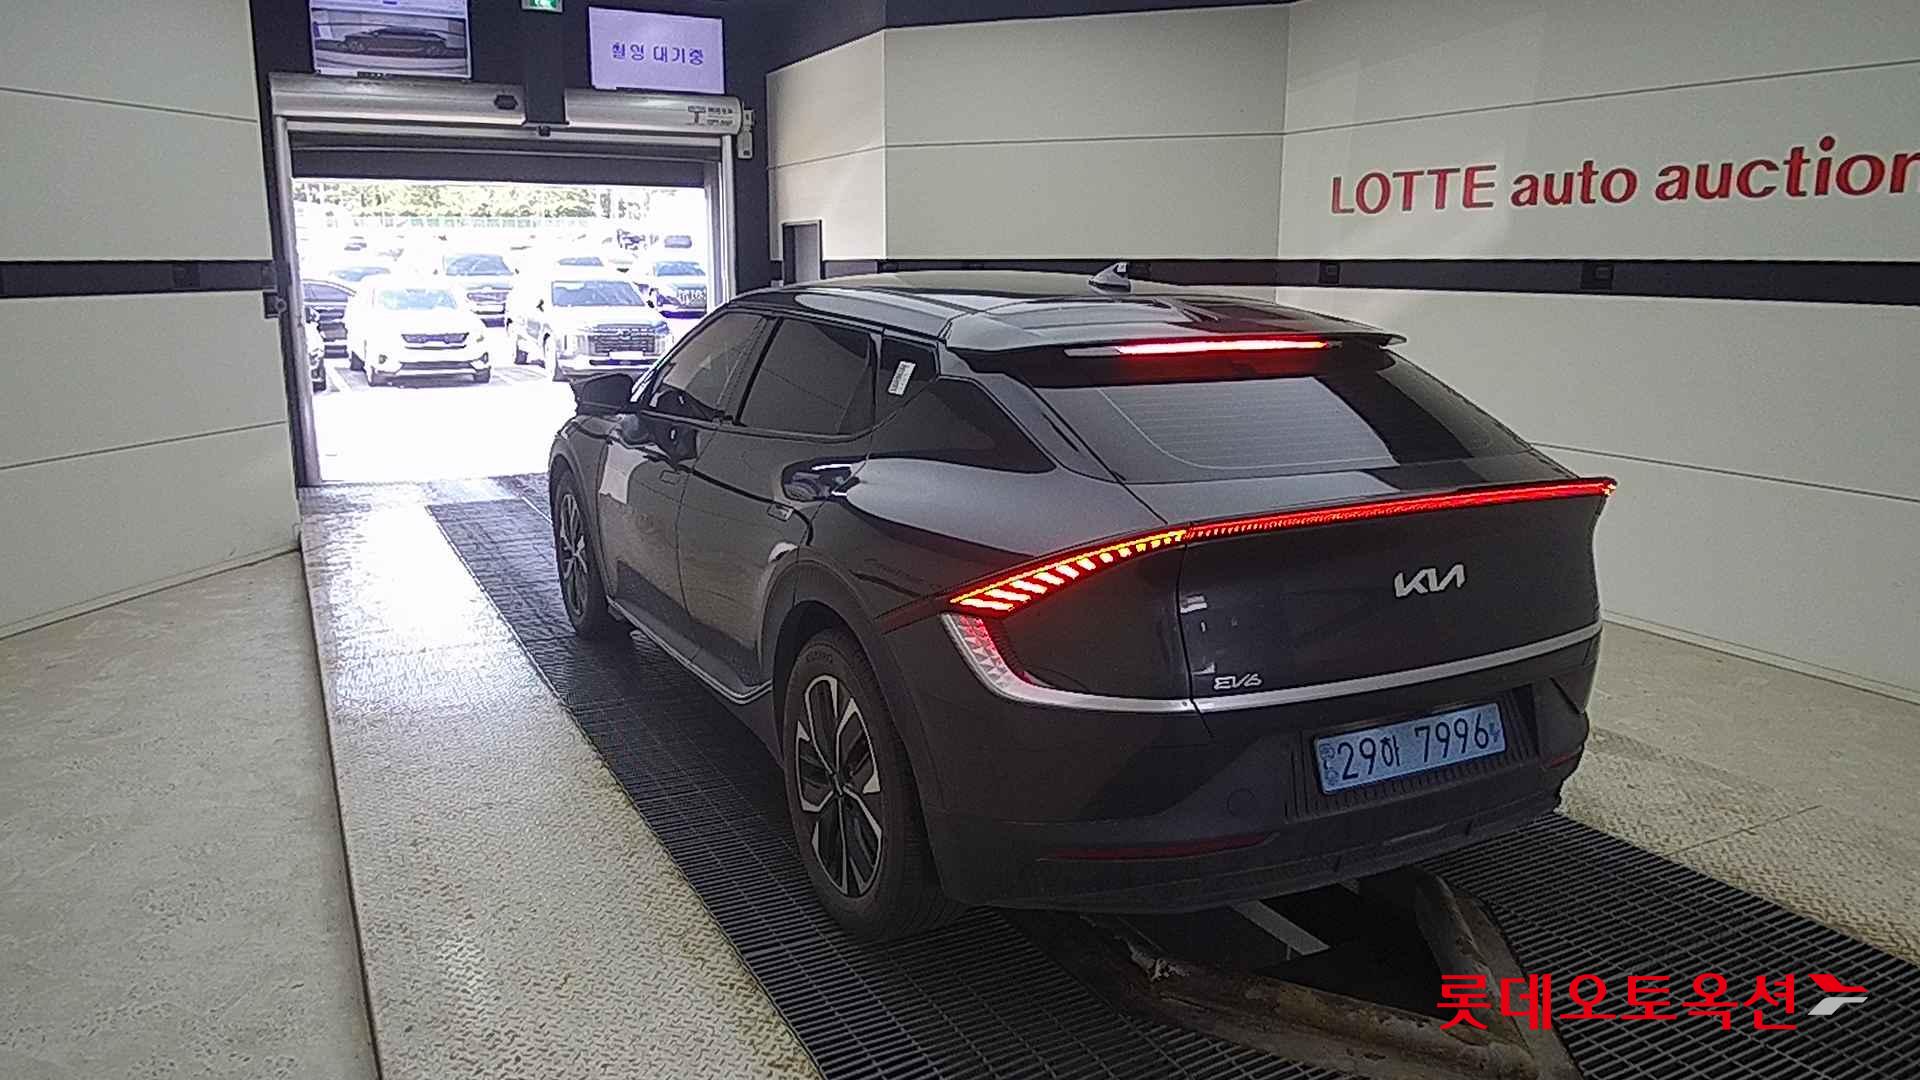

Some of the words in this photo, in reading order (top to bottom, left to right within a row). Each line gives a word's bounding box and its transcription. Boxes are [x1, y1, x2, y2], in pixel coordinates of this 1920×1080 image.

[653, 46, 704, 65] 대기중
[1331, 164, 1497, 214] LOTTE
[1510, 160, 1637, 208] auto
[1213, 673, 1262, 690] EV6
[1337, 734, 1400, 780] 29하
[1414, 712, 1489, 763] 7996
